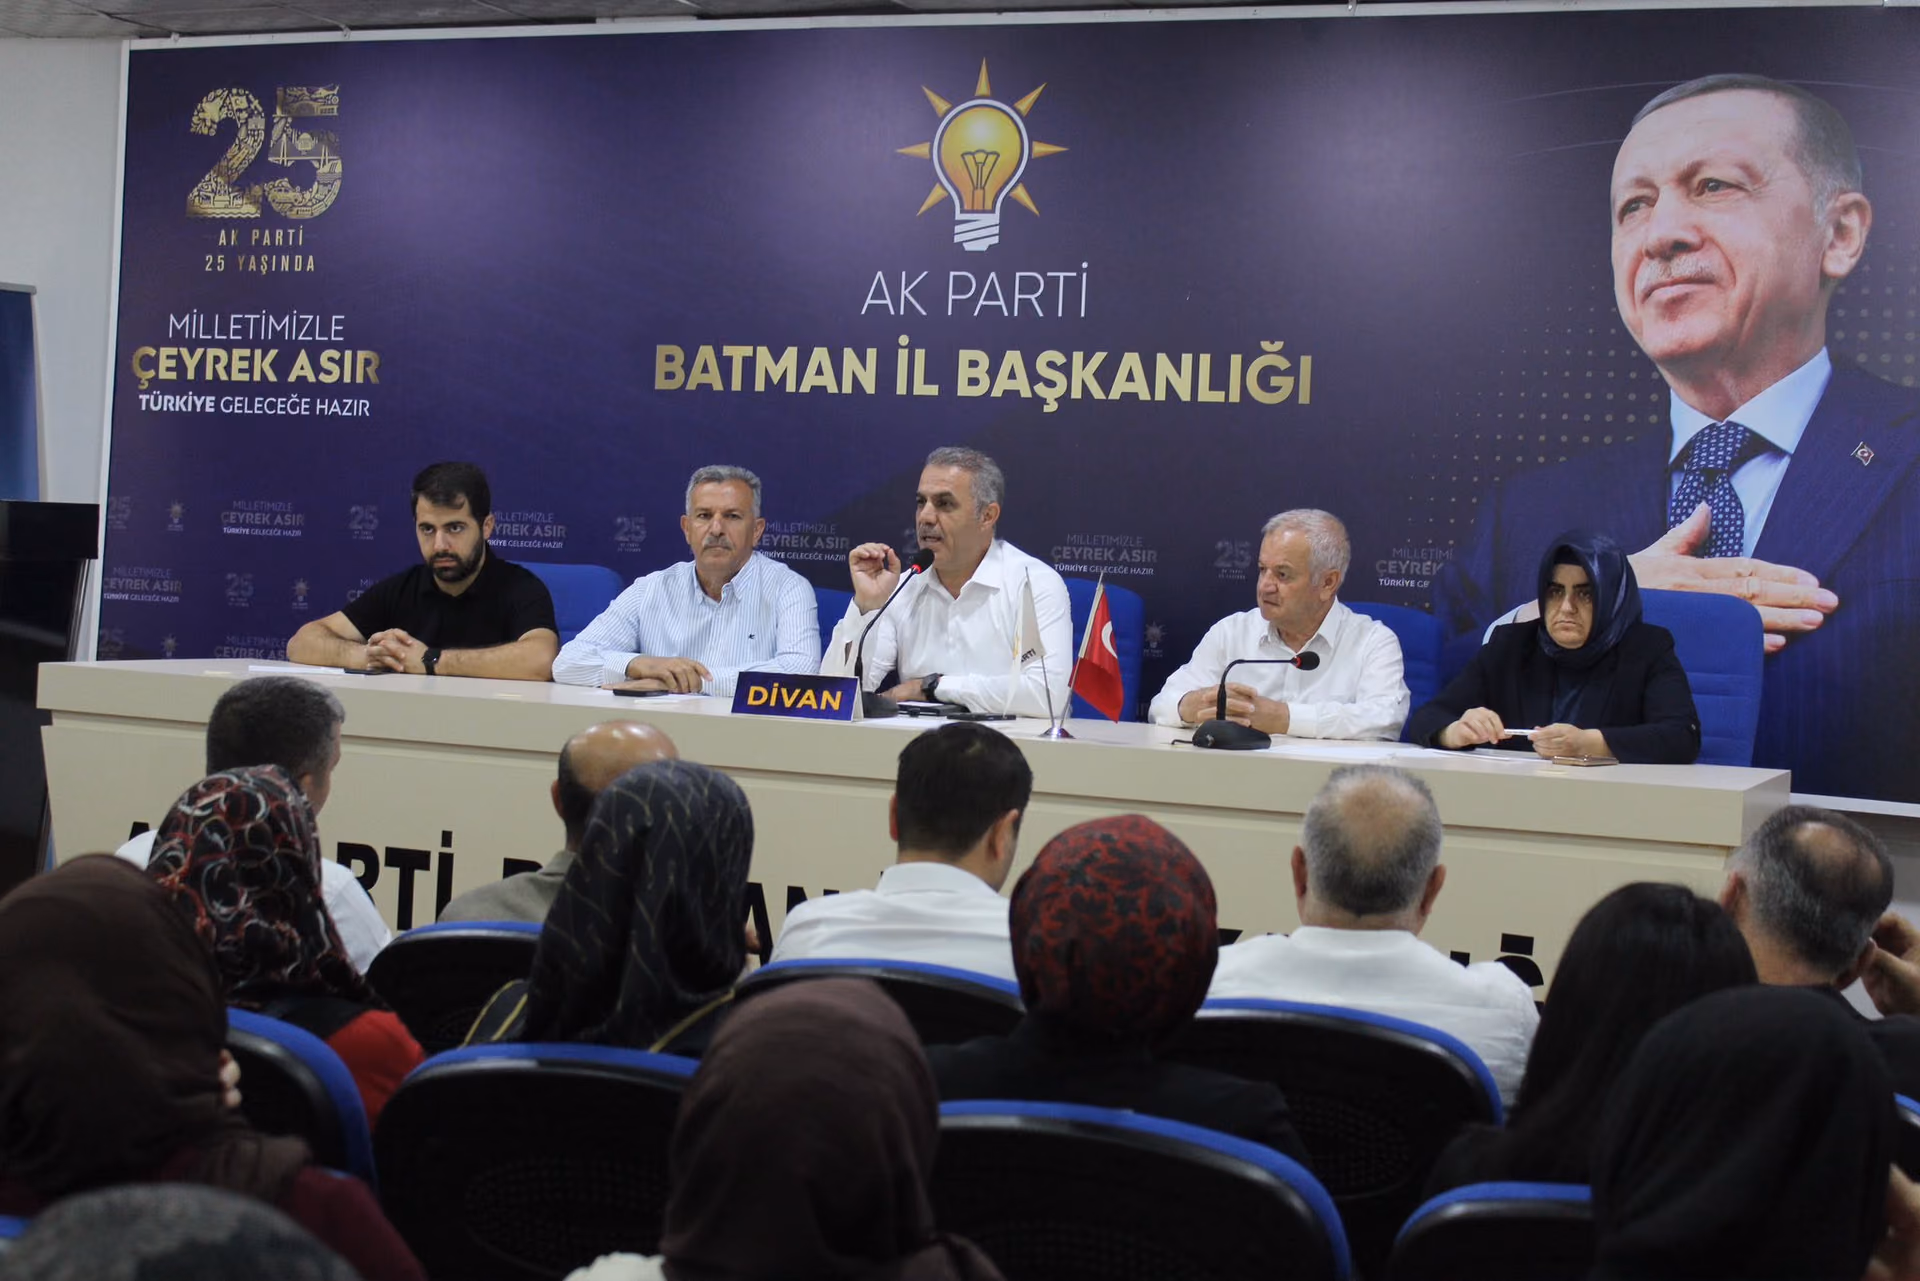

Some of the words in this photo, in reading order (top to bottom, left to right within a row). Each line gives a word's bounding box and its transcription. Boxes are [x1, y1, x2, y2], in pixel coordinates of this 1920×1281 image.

[186, 84, 342, 219] 25
[218, 229, 239, 246] AK
[252, 225, 304, 246] PARTİ
[205, 255, 226, 272] 25
[238, 255, 315, 275] YAŞINDA
[861, 270, 931, 316] AK
[947, 261, 1089, 318] PARTİ
[168, 309, 346, 342] MİLLETİMİZLE
[132, 346, 279, 390] ÇEYREK
[287, 349, 381, 385] ASIR
[654, 344, 878, 395] BATMAN
[896, 334, 939, 396] İL
[956, 340, 1312, 413] BAŞKANLIĞI
[139, 391, 215, 414] TÜRKİYE
[220, 392, 310, 416] GELECEĞE
[316, 399, 371, 417] HAZIR
[220, 511, 271, 526] ÇEYREK
[274, 513, 305, 526] ASIR
[349, 504, 379, 530] 25
[494, 523, 529, 537] YREK
[533, 524, 567, 538] ASIR
[614, 514, 647, 542] 25
[757, 534, 809, 549] EYREK
[814, 537, 850, 550] ASIR
[1051, 545, 1114, 562] ÇEYREK
[1118, 549, 1158, 563] ASIR
[1214, 540, 1251, 568] 25
[1379, 577, 1415, 588] TÜRKİYE
[746, 682, 843, 711] DİVAN
[336, 830, 454, 931] RTİ
